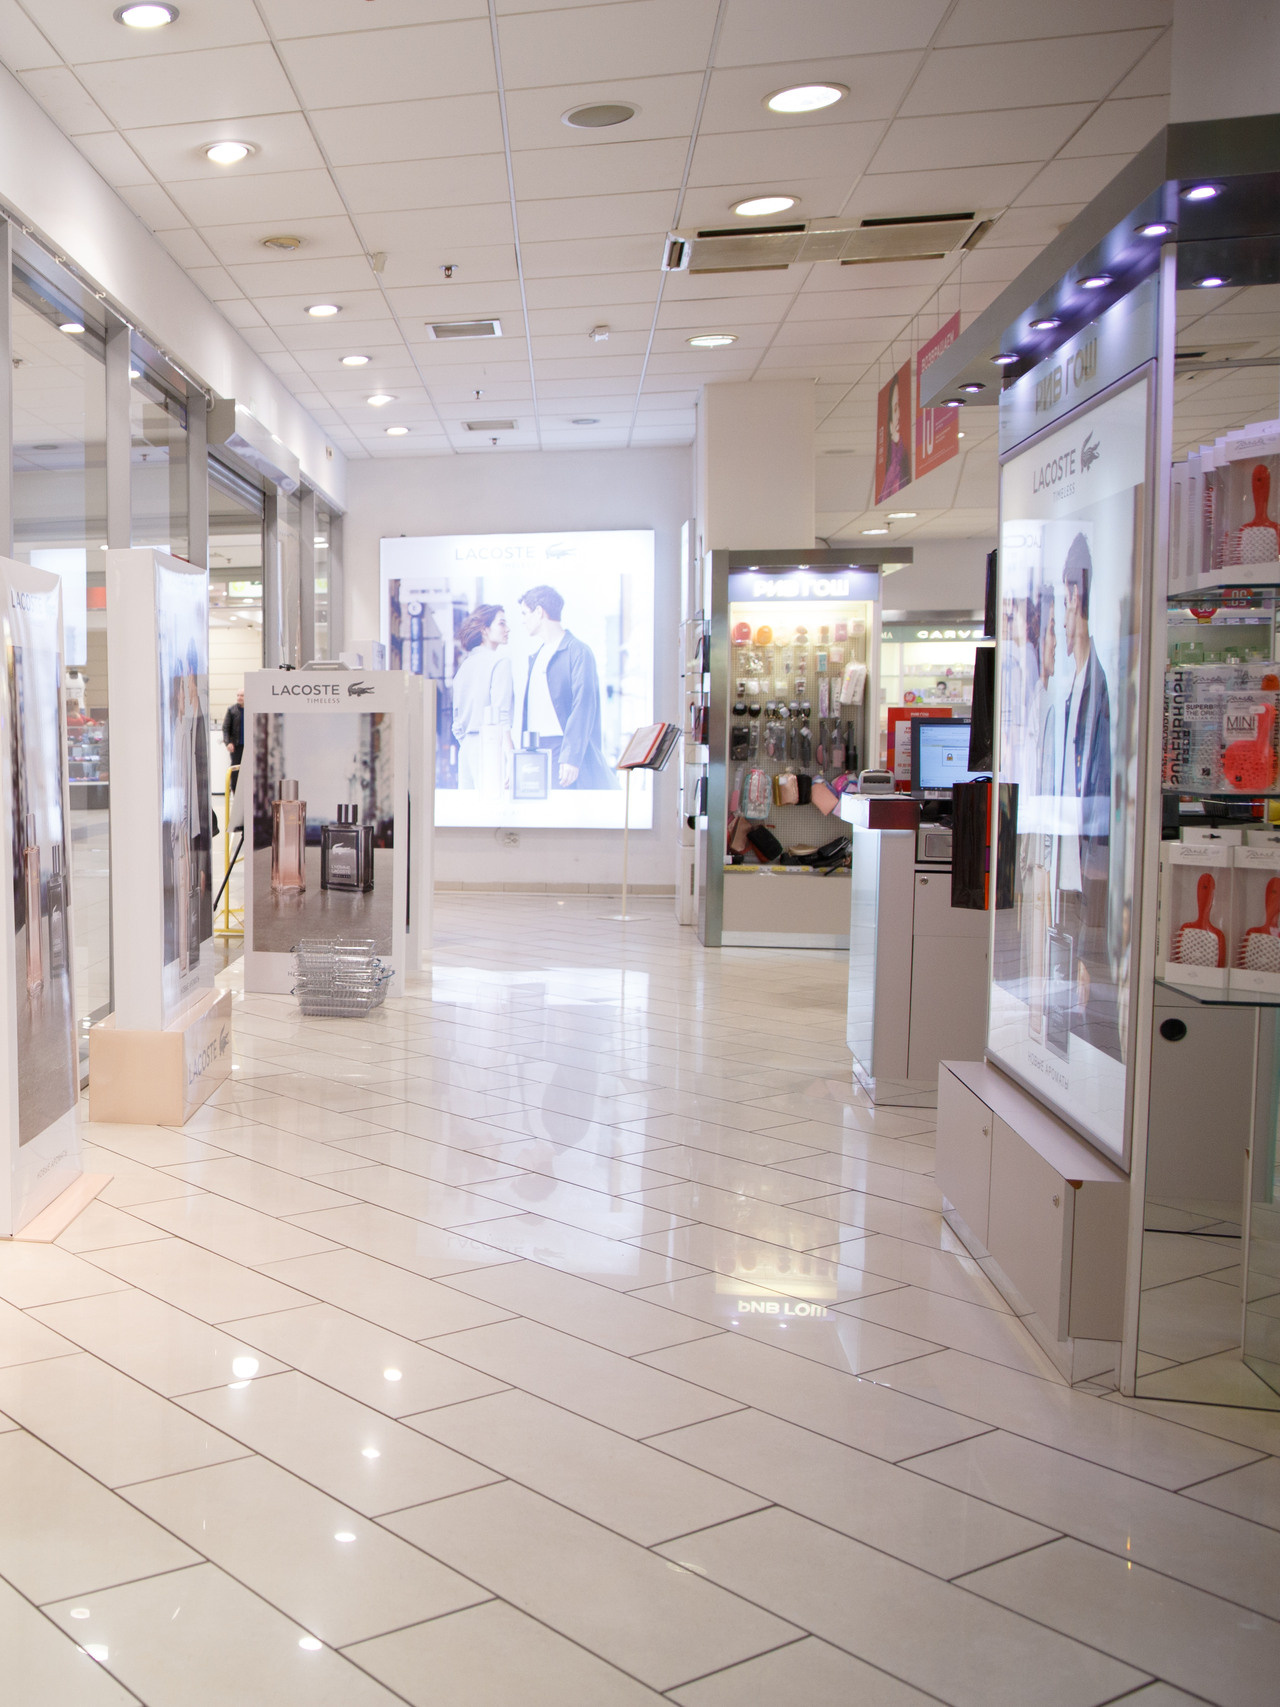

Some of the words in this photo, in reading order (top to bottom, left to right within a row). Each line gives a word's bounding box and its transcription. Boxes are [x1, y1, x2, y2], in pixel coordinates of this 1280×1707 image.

[1035, 364, 1063, 416] РИВ
[1065, 337, 1098, 396] ГОШ
[1033, 448, 1076, 494] LACOSTE
[1053, 482, 1076, 500] TIMELESS
[455, 546, 536, 560] LACOSTE
[271, 684, 340, 696] LACOSTE
[1227, 716, 1256, 728] MINI
[188, 1038, 217, 1085] LACOSTE
